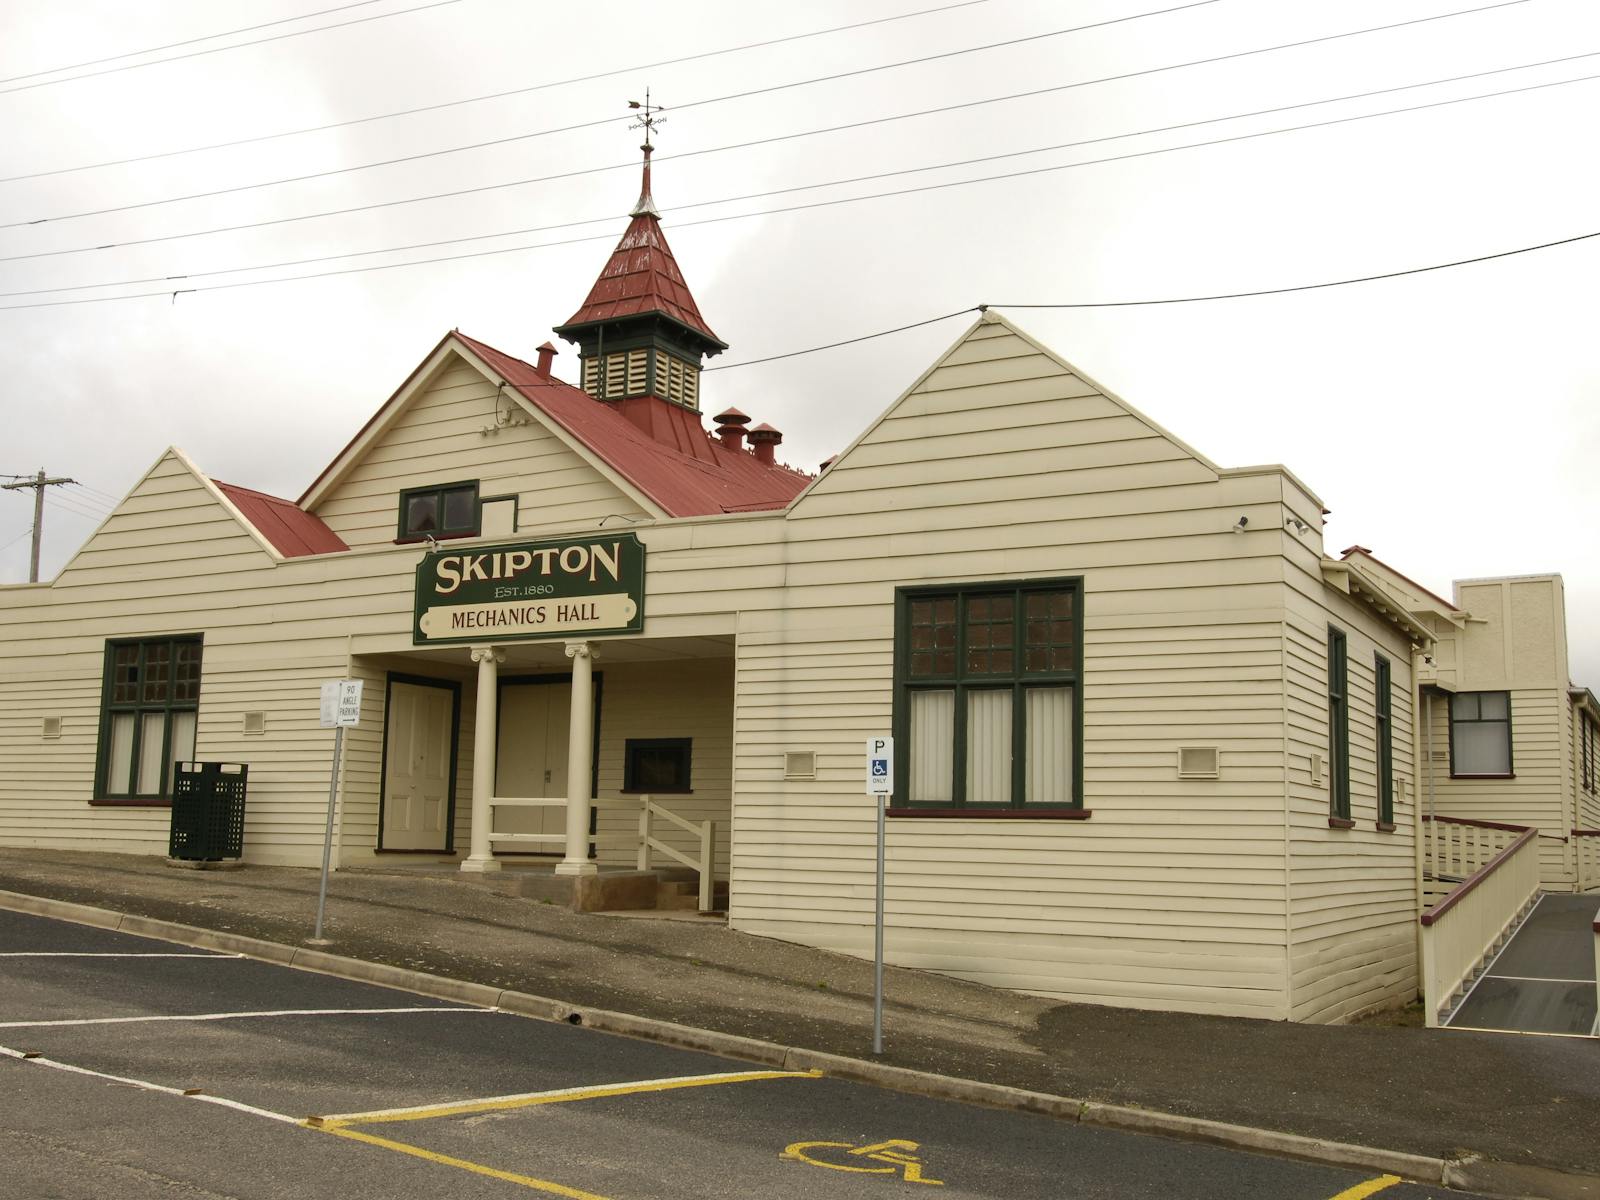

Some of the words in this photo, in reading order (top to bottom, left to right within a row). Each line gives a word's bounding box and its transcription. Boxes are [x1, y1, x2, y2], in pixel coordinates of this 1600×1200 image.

[434, 542, 621, 594] SKIPTON
[451, 606, 546, 629] MECHANICS
[557, 603, 600, 622] HALL
[346, 685, 356, 694] 90
[342, 696, 357, 705] ANGLE
[339, 707, 359, 716] PARKING
[875, 740, 885, 753] P
